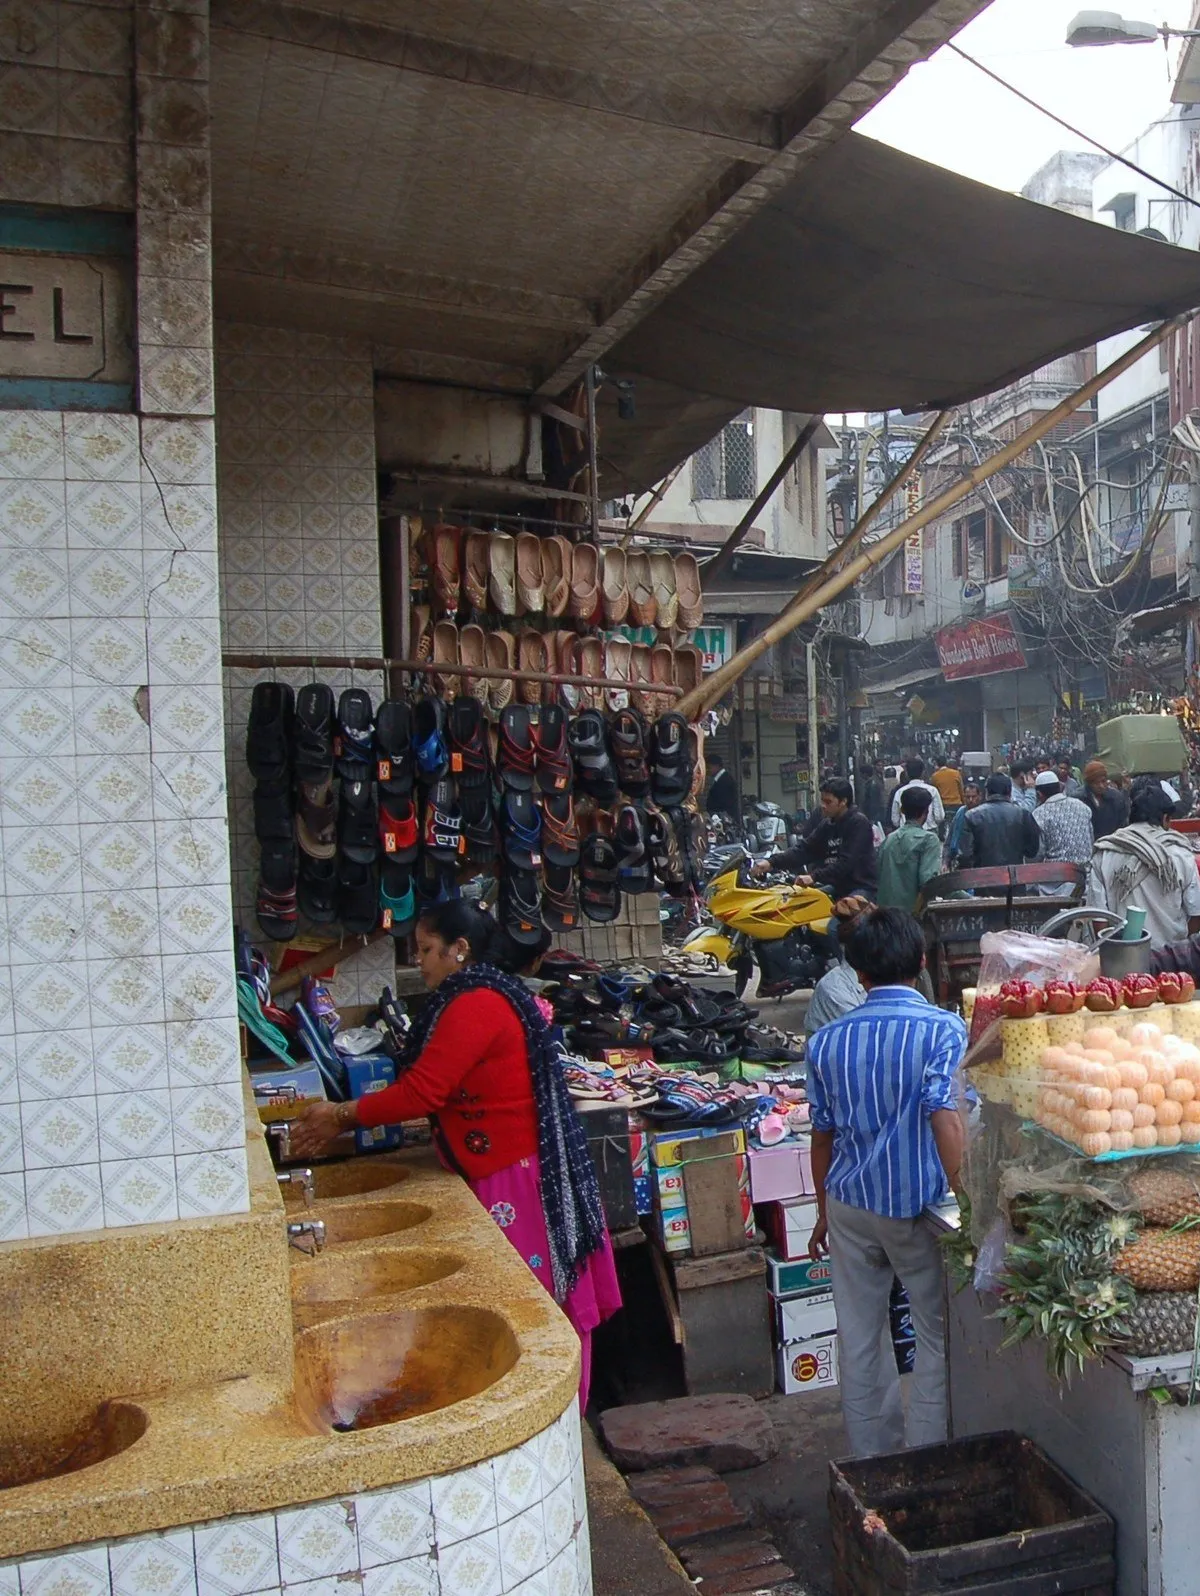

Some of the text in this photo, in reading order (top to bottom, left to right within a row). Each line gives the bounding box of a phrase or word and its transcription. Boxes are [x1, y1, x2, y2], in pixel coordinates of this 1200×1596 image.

[0, 284, 93, 343] EL
[799, 1358, 815, 1379] 10
[815, 1340, 835, 1384] Total
